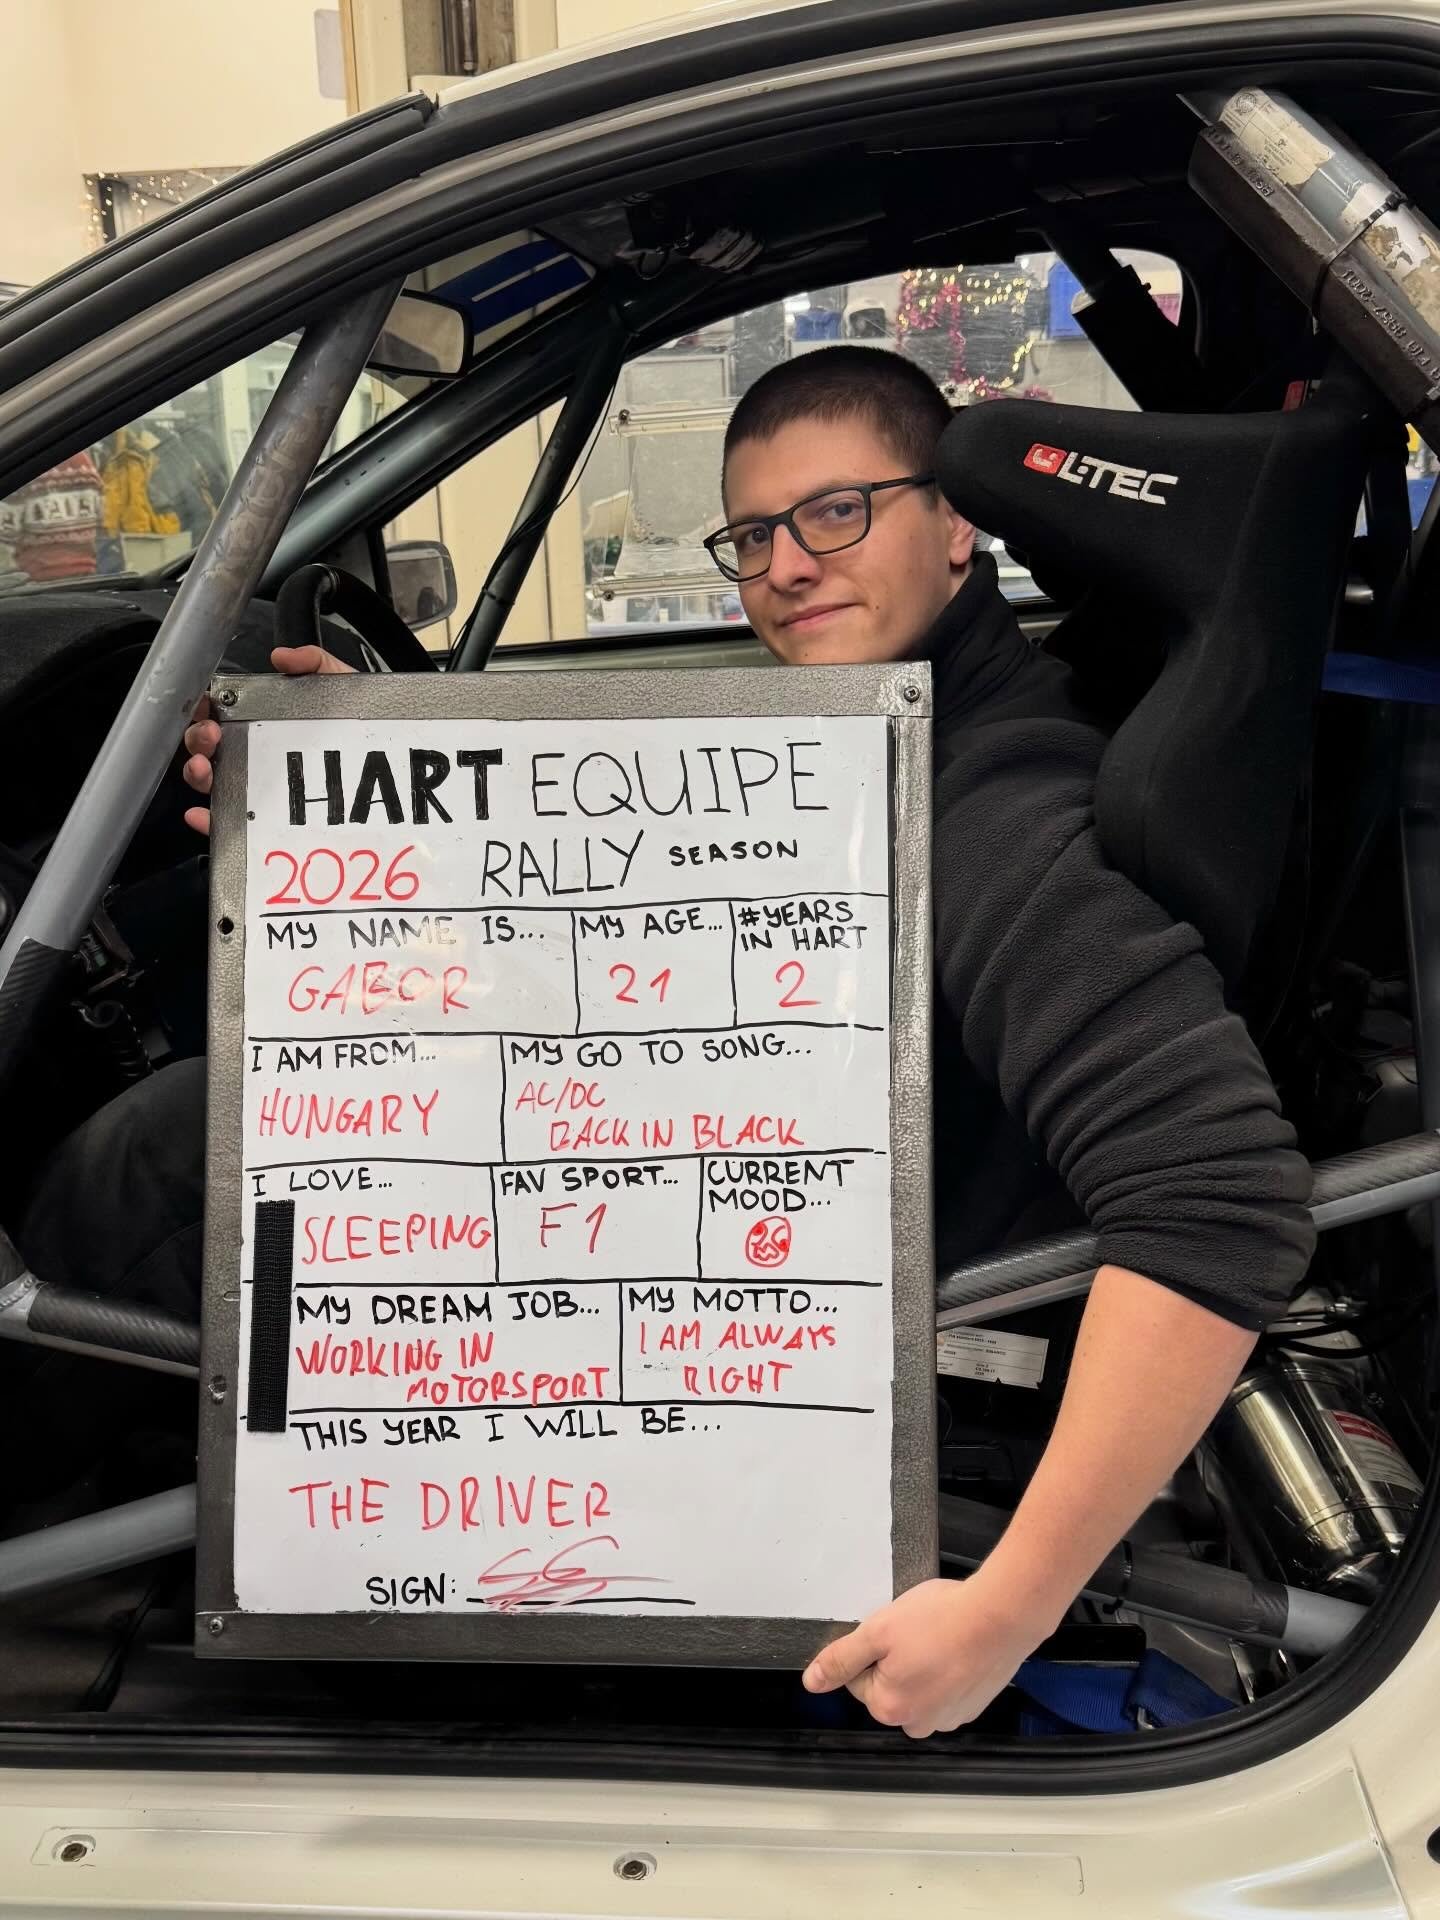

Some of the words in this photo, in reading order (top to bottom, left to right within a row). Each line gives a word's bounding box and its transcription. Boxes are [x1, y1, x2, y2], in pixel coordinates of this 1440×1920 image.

[286, 747, 503, 826] HART
[531, 741, 829, 817] EQUIPE
[263, 845, 421, 907] 2026
[481, 829, 645, 898] RALLY
[668, 839, 798, 867] SEASON
[579, 915, 625, 940] MY
[643, 910, 723, 937] AGE...
[737, 900, 854, 929] #YEARS
[266, 921, 318, 950] MY
[348, 915, 453, 948] NAME
[481, 915, 545, 945] IS...
[740, 929, 773, 952] IN
[791, 924, 868, 951] HART
[607, 962, 672, 1005] 21
[773, 959, 817, 1009] 2
[251, 1045, 263, 1073] I
[276, 1046, 322, 1072] AM
[334, 1039, 438, 1069] FROM...
[510, 1041, 564, 1066] MY
[576, 1040, 622, 1068] GO
[639, 1039, 684, 1066] TO
[701, 1032, 811, 1062] SONG...
[515, 1078, 605, 1110] AC/DC
[259, 1087, 439, 1139] HUNGARY
[549, 1120, 630, 1152] BACK
[641, 1119, 674, 1149] IN
[696, 1112, 803, 1150] BLACK
[251, 1173, 267, 1197] I
[287, 1164, 393, 1192] LOVE...
[500, 1168, 546, 1196] FAV
[561, 1165, 679, 1192] SPORT...
[707, 1159, 855, 1187] CURRENT
[708, 1187, 831, 1213] MOOD...
[302, 1212, 492, 1265] SLEEPING
[540, 1203, 608, 1253] F1
[296, 1294, 351, 1325] MY
[371, 1291, 492, 1325] DREAM
[508, 1290, 600, 1321] JOB...
[628, 1286, 675, 1314] MY
[693, 1286, 838, 1314] MOTTO...
[295, 1334, 443, 1377] WORKING
[458, 1331, 495, 1367] IN
[639, 1323, 646, 1354] I
[658, 1322, 702, 1351] AM
[718, 1320, 837, 1351] ALWAYS
[404, 1364, 609, 1405] MOTORSPORT
[683, 1359, 793, 1396] RIGHT
[289, 1418, 368, 1452] THIS
[382, 1416, 461, 1446] YEAR
[485, 1413, 505, 1443] I
[524, 1408, 618, 1439] WILL
[640, 1406, 721, 1435] BE...
[288, 1476, 390, 1530] THE
[419, 1474, 609, 1533] DRIVER
[365, 1572, 456, 1607] SIGN:
